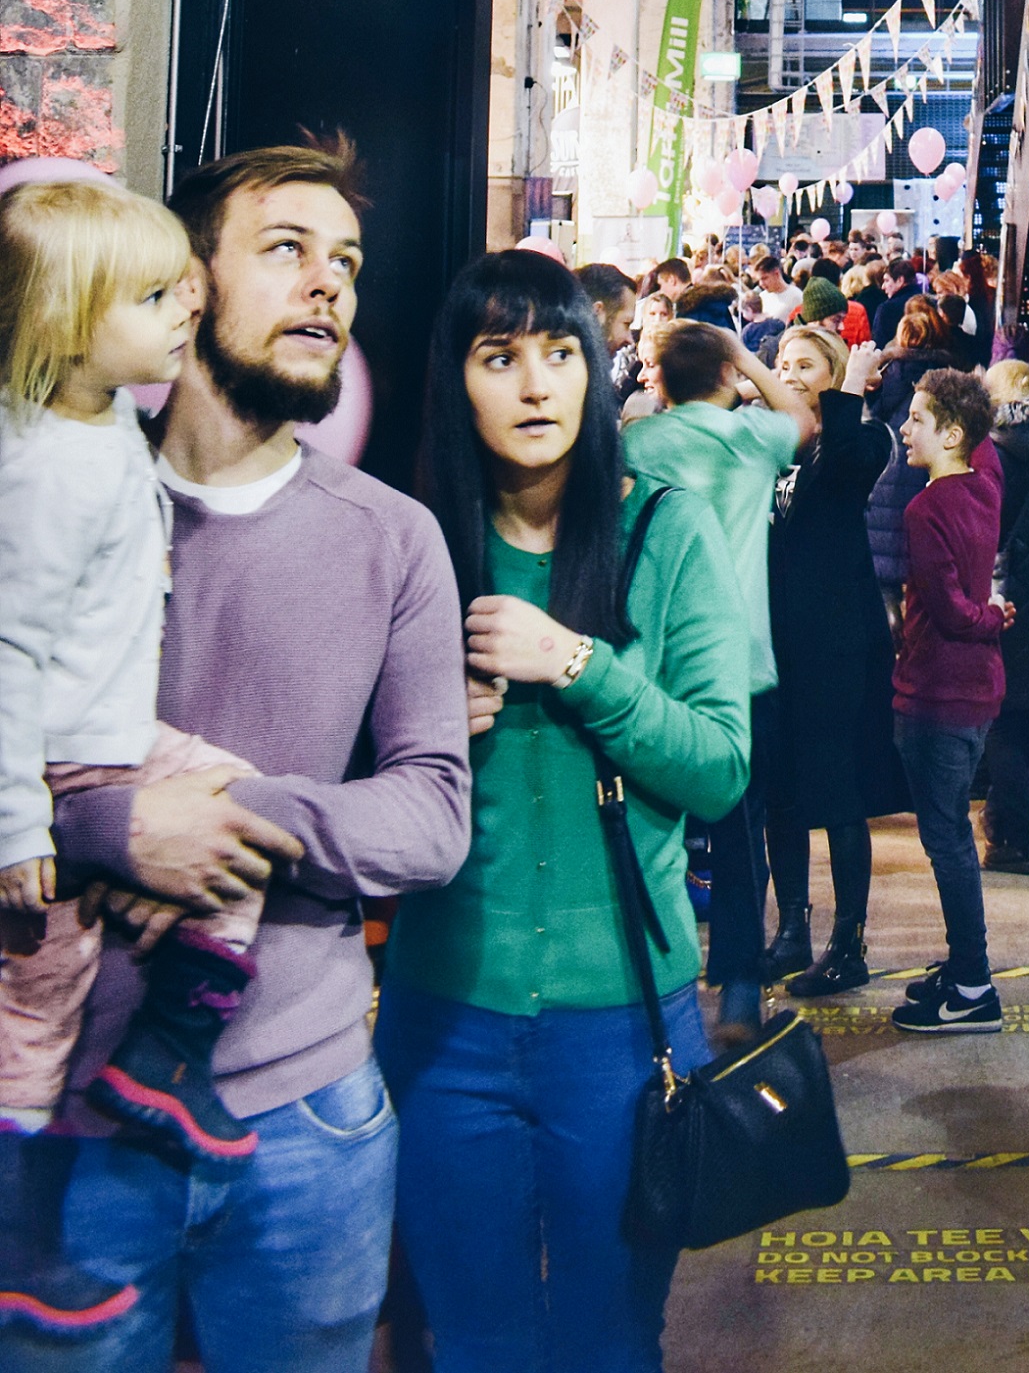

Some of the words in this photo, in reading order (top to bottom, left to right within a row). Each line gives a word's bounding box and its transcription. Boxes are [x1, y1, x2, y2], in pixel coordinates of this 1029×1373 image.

[664, 15, 690, 90] Mill
[760, 1230, 893, 1248] HOIA
[907, 1228, 1005, 1247] TEE
[758, 1250, 815, 1264] DO
[822, 1249, 900, 1265] NOT
[910, 1248, 1029, 1264] BLOCK
[754, 1267, 876, 1285] KEEP
[888, 1266, 1016, 1284] AREA
